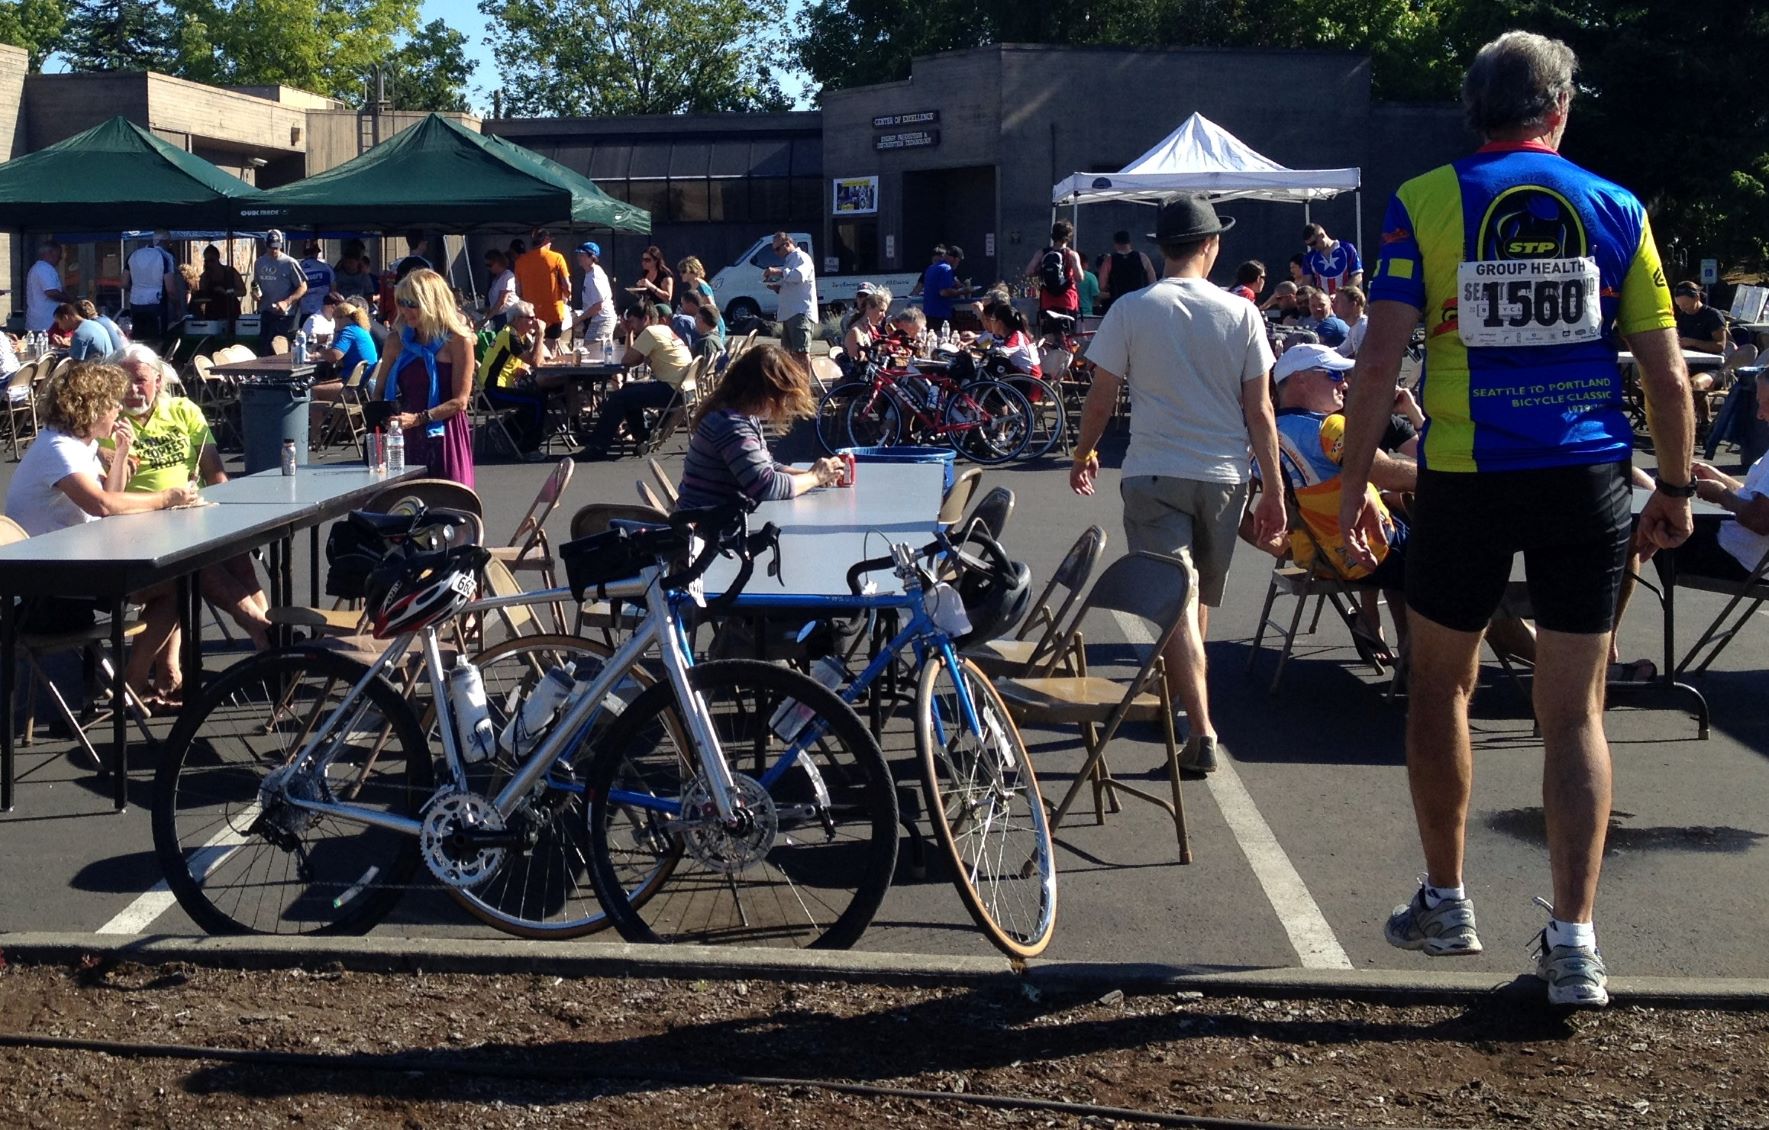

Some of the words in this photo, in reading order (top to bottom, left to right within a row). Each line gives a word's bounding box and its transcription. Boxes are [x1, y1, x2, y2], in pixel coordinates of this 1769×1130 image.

[1508, 242, 1556, 254] STP
[1476, 262, 1528, 276] GROUP
[1530, 260, 1586, 274] HEALTH
[1483, 279, 1584, 328] 1560
[1473, 386, 1526, 398] SEATTLE
[1530, 385, 1546, 394] TO
[1549, 377, 1611, 391] PORTLAND
[1512, 394, 1565, 407] BICYCLE
[1567, 390, 1612, 401] CLASSIC
